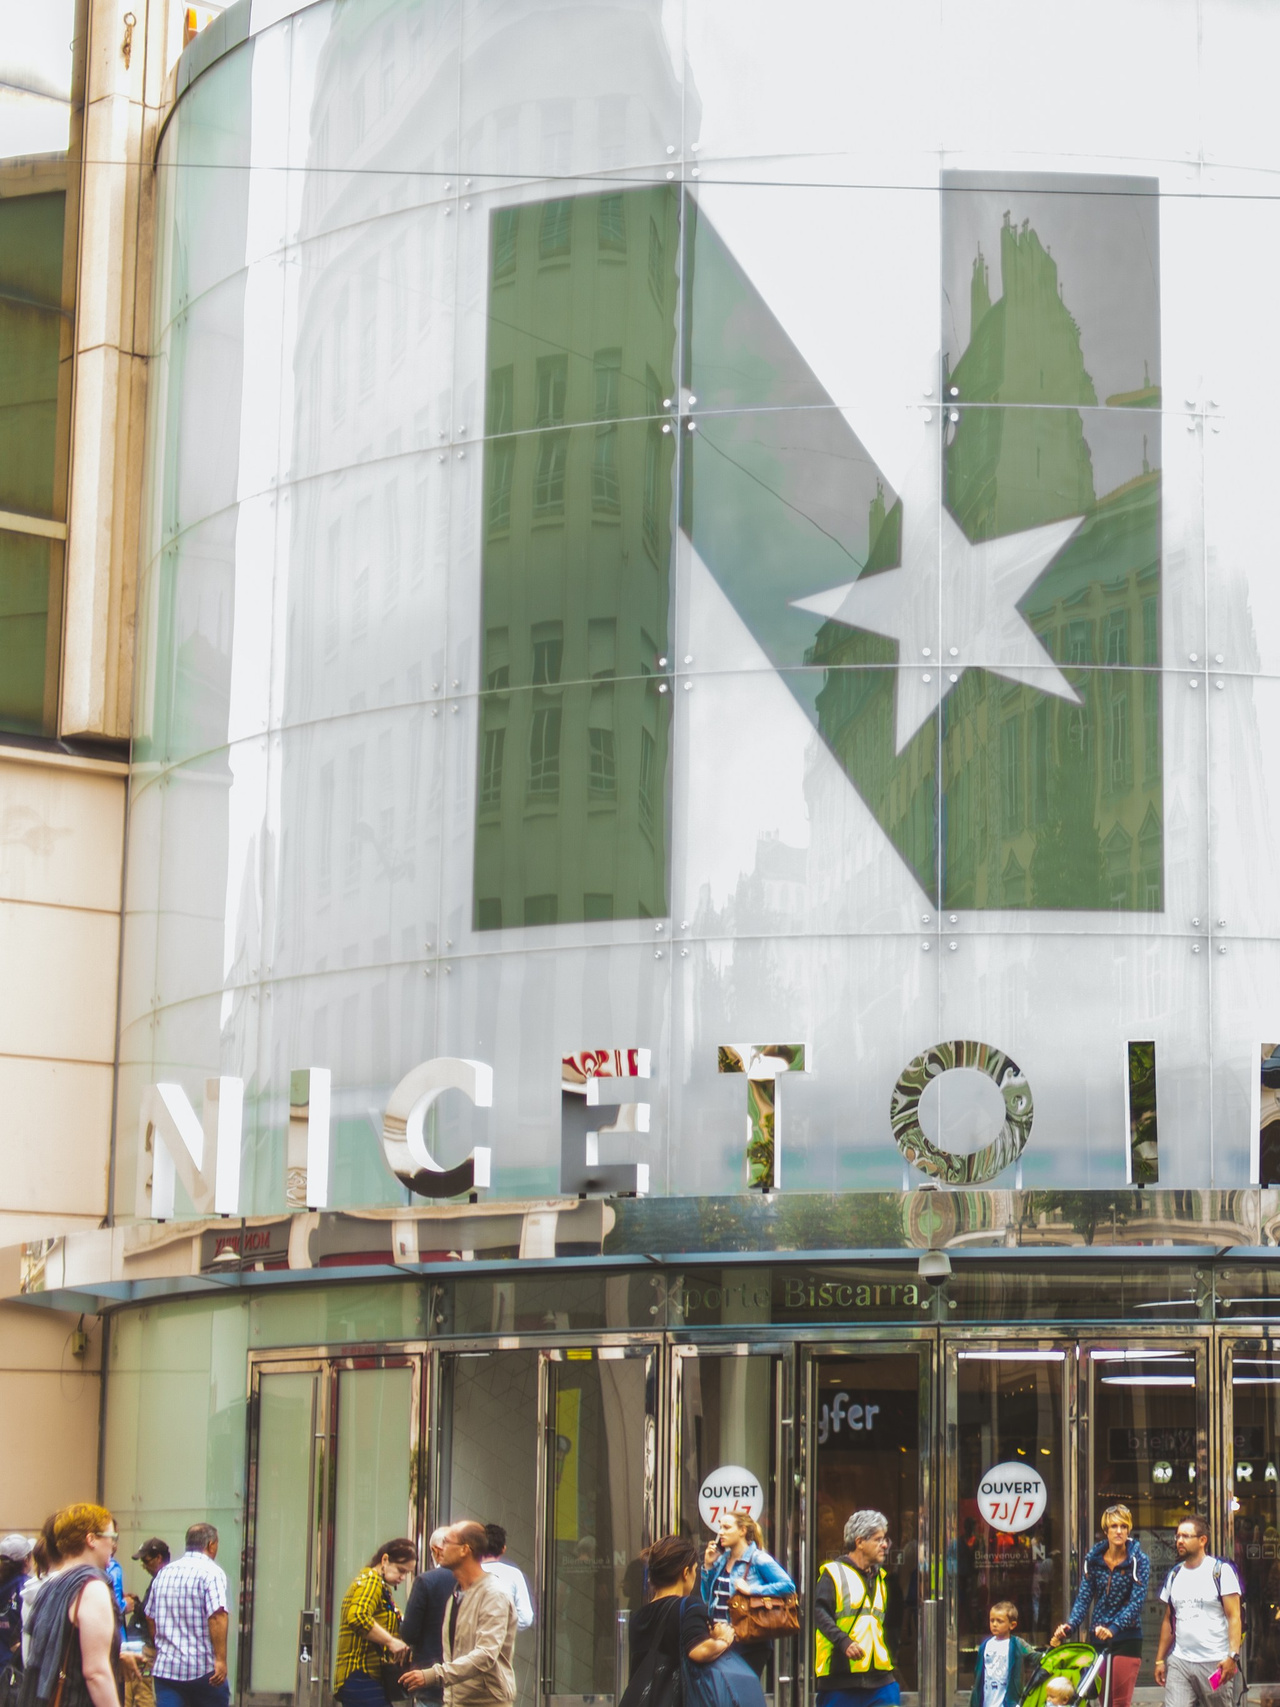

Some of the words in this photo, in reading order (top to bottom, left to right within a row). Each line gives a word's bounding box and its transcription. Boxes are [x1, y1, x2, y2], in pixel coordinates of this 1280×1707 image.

[783, 1277, 919, 1308] Biscarra
[702, 1485, 758, 1499] OUVERT
[981, 1482, 1041, 1495] OUVERT
[989, 1496, 1034, 1525] 7J/7
[975, 1551, 1021, 1560] Bienvenue
